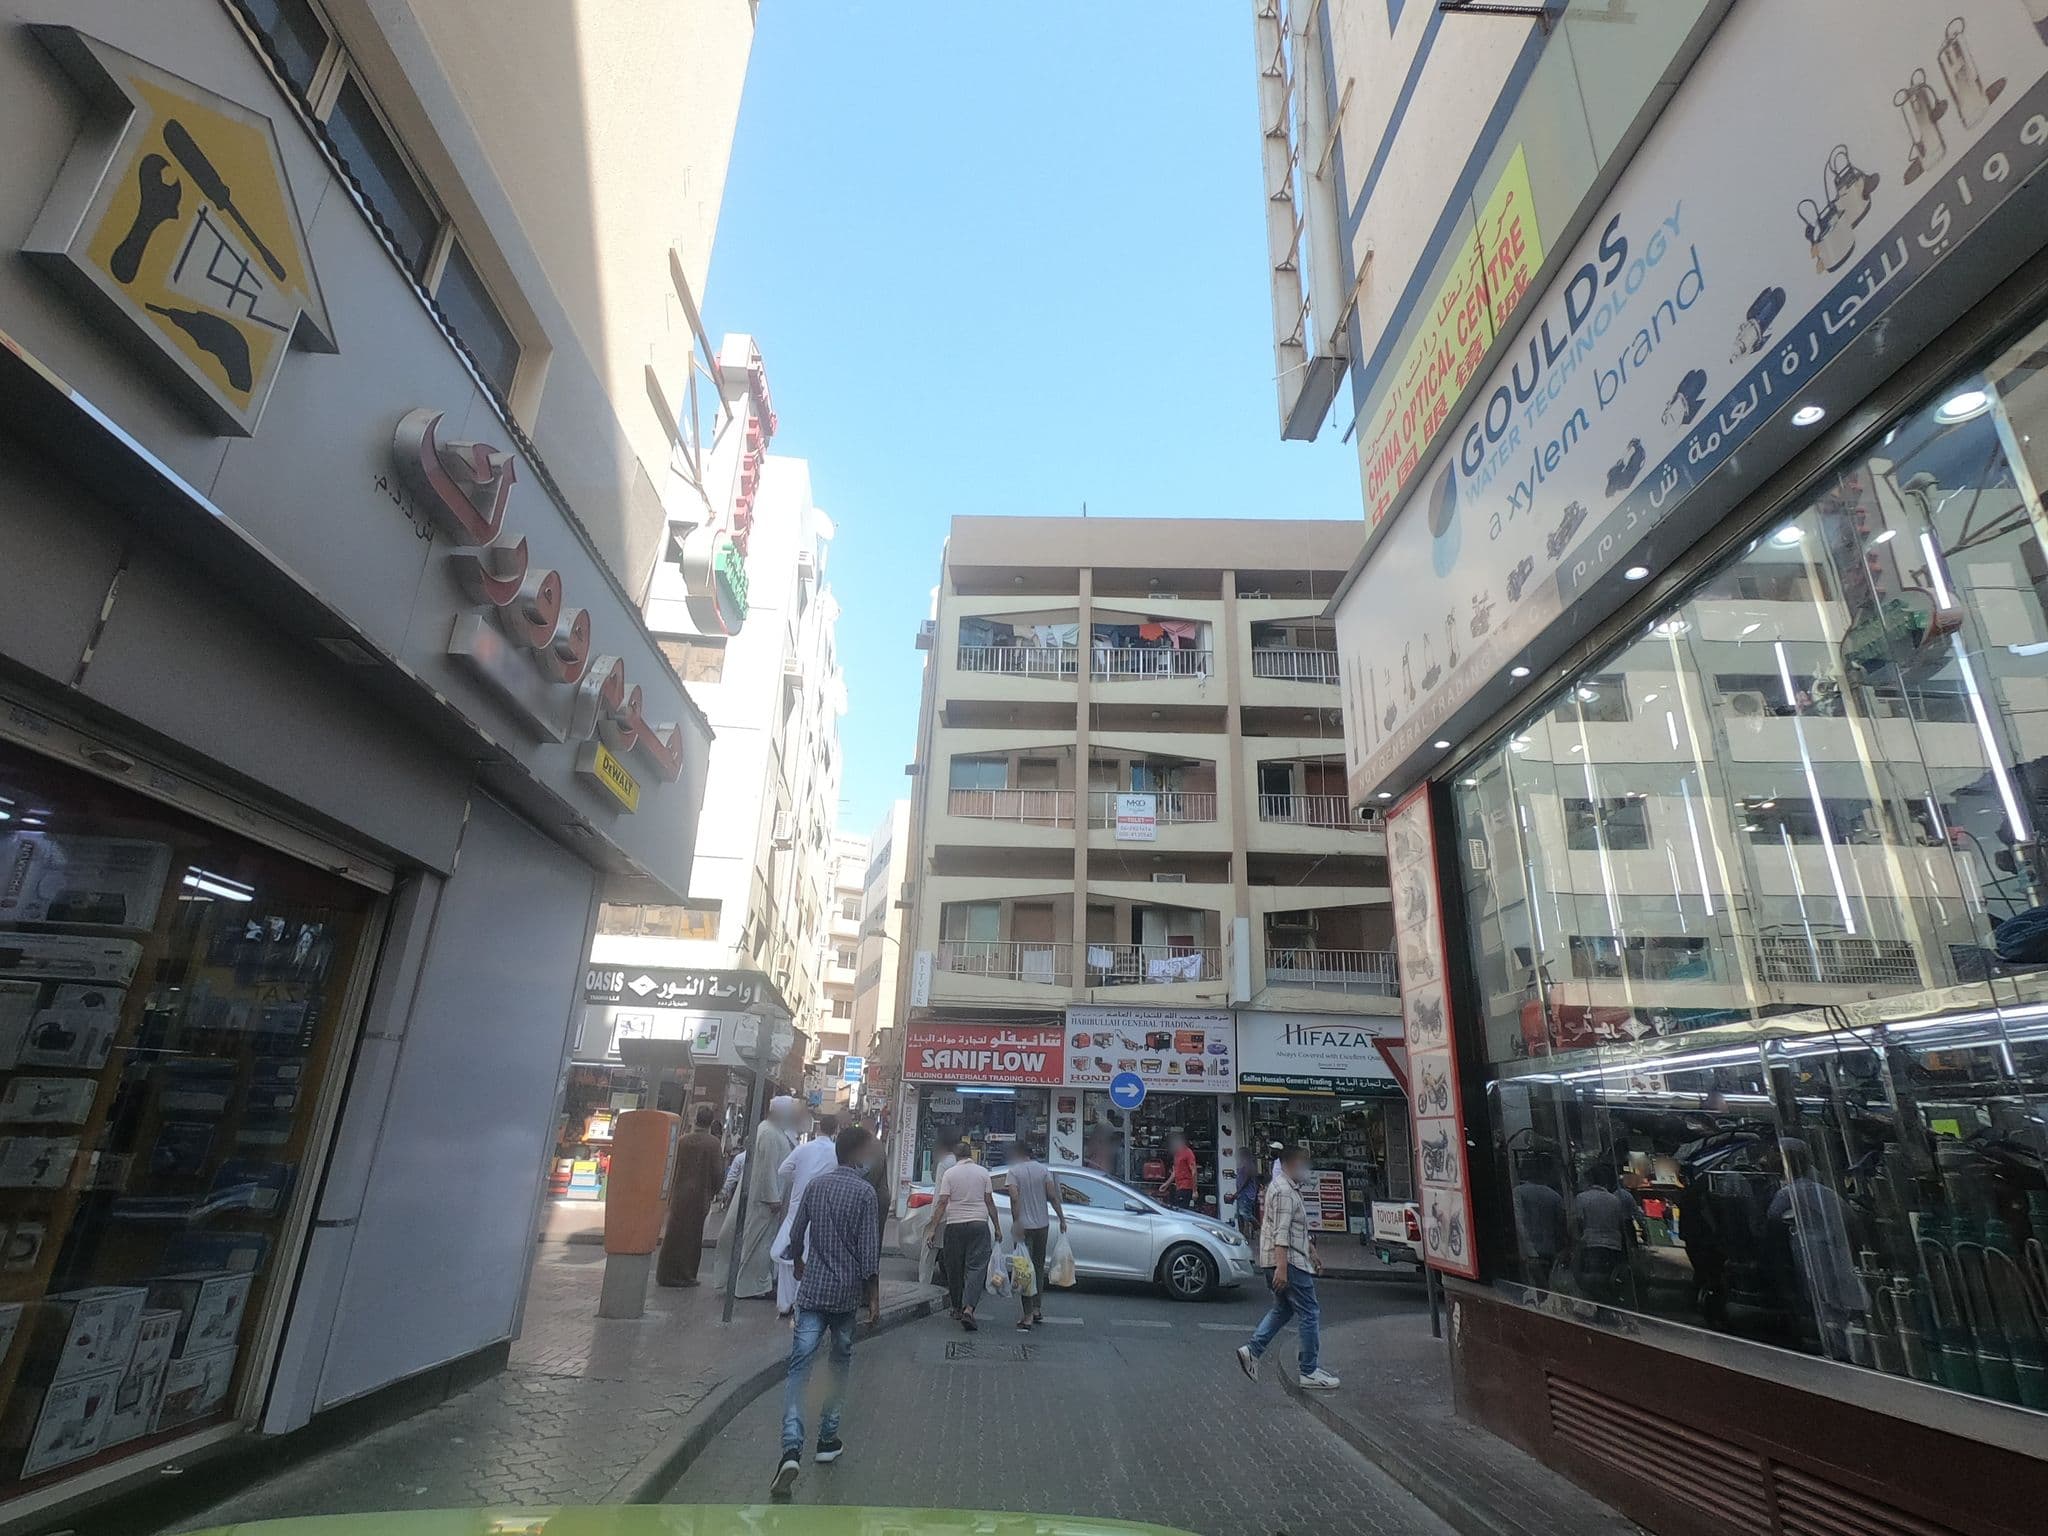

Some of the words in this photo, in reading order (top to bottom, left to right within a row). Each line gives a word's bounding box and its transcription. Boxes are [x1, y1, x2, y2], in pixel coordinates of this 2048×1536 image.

[1781, 236, 1910, 375] للتجارة
[1367, 432, 1401, 501] CHINA
[1402, 336, 1456, 445] OPTICAL
[1456, 214, 1527, 347] CENTRE
[1460, 212, 1629, 478] GOULDS
[1465, 424, 1522, 508] WATER
[1524, 199, 1683, 430] TECHNOLOGY
[1488, 510, 1502, 542] a
[1507, 407, 1591, 522] xylem
[1594, 243, 1705, 411] brand
[1687, 370, 1773, 465] العامة
[585, 971, 625, 992] OASIS
[656, 974, 705, 1000] النور
[1121, 1019, 1158, 1027] GENERAL
[1160, 1020, 1195, 1028] TRADING
[1285, 1023, 1379, 1048] HIFAZAT
[936, 1034, 957, 1045] مواد
[921, 1048, 1047, 1073] SANIFLOW
[905, 1072, 943, 1080] BUILDING
[944, 1073, 988, 1081] MATERIALS
[989, 1074, 1024, 1083] TRADING
[1070, 1074, 1111, 1083] HOND
[1261, 1076, 1286, 1084] Hussain
[1286, 1077, 1310, 1085] General
[1309, 1078, 1332, 1087] Trading
[1377, 1208, 1399, 1225] TOYOTA
